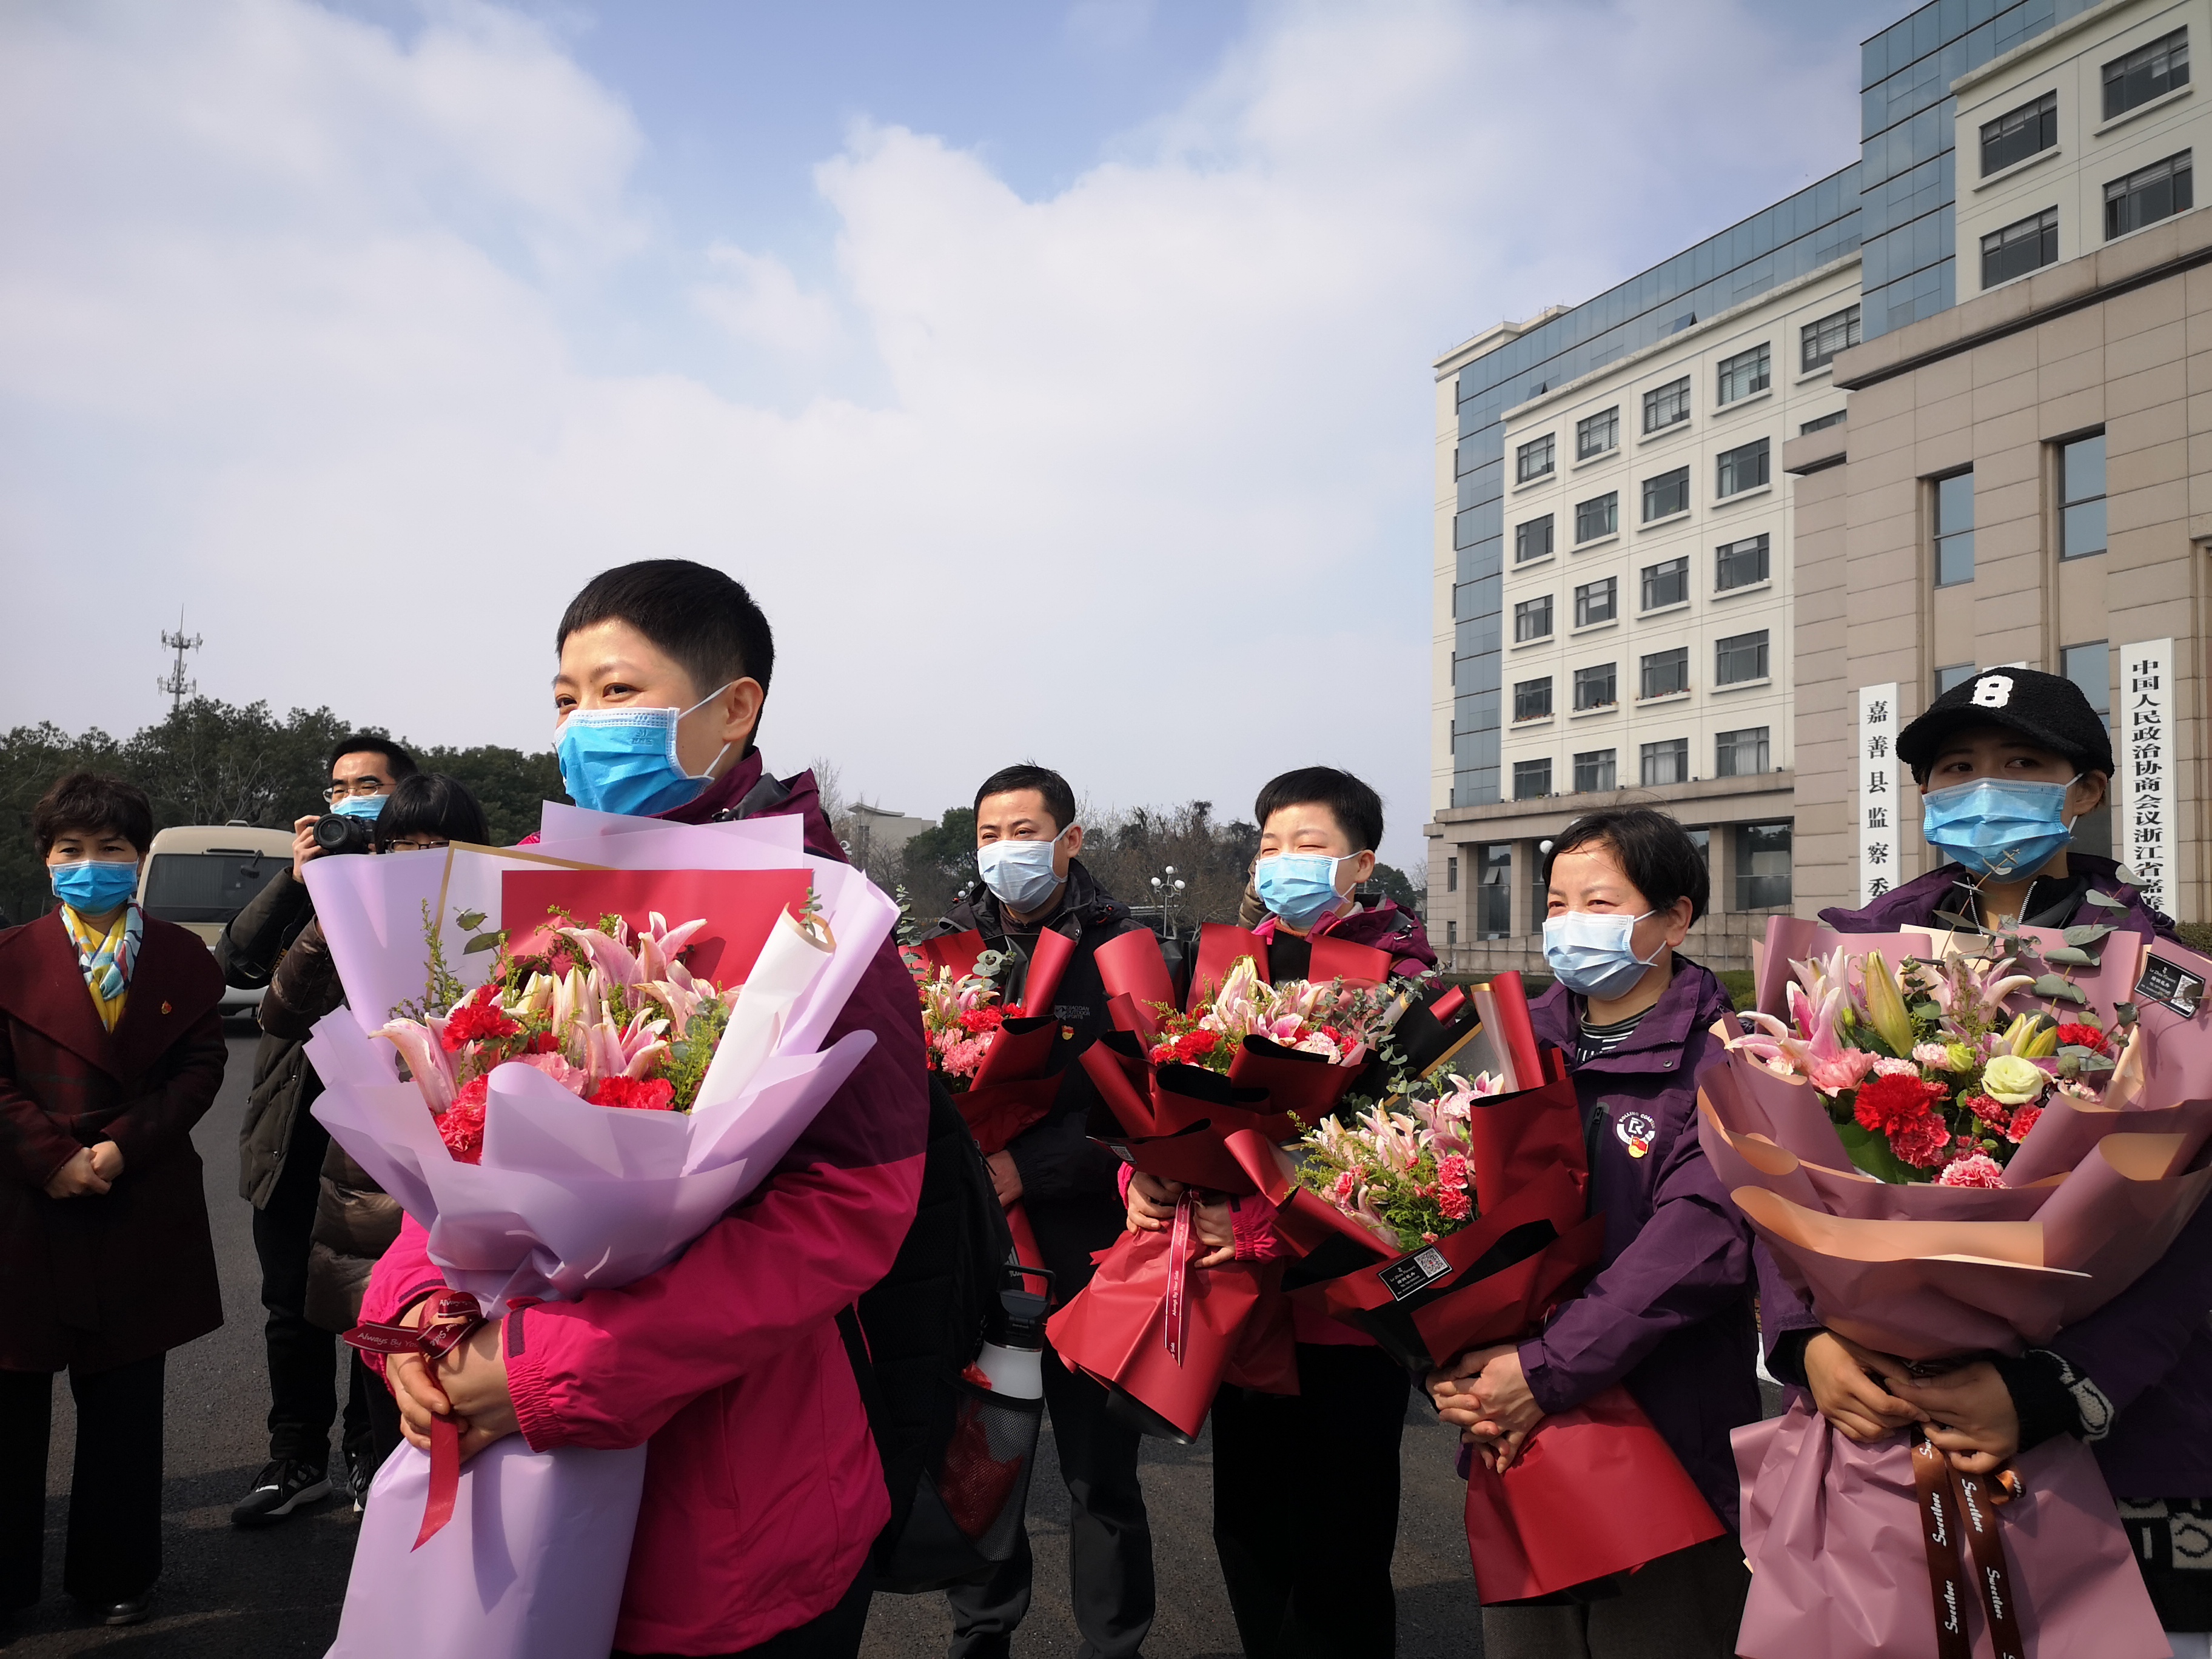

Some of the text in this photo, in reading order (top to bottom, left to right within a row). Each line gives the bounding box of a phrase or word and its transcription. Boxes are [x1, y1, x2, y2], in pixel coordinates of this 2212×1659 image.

[357, 1332, 387, 1346] Always
[390, 1338, 401, 1347] By
[429, 1330, 447, 1346] Side
[1931, 1492, 1946, 1546] Sweetlove
[1962, 1478, 1983, 1533] Sweetlove
[1943, 1580, 1959, 1634] Sweetlove
[1986, 1566, 2003, 1620] Sweetlove
